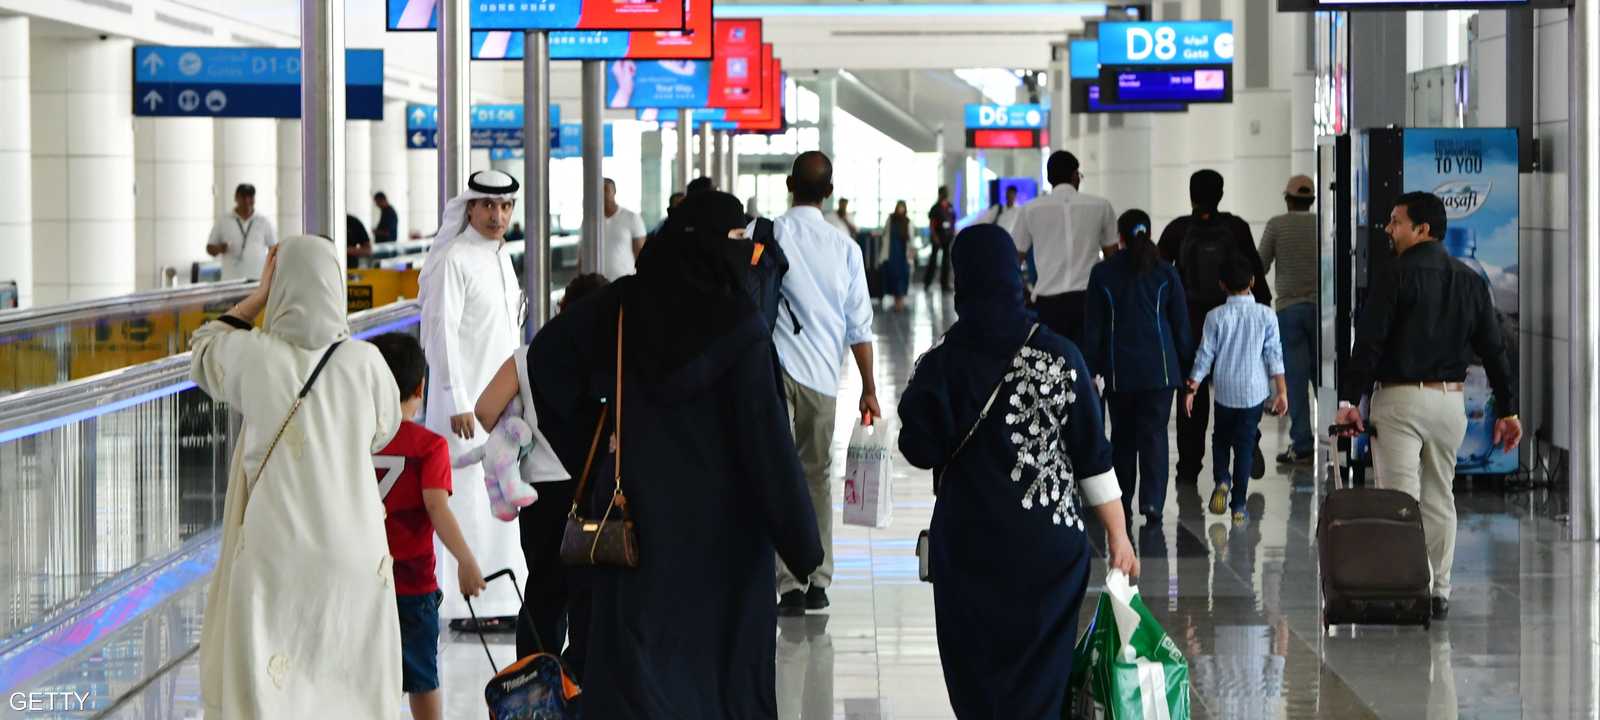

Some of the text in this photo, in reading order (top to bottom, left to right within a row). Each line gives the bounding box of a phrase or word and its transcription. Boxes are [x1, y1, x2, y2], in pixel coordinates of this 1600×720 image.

[1126, 26, 1177, 60] D8
[1183, 48, 1209, 59] Gate
[252, 57, 301, 75] D1-D
[979, 106, 1009, 126] D6
[1435, 157, 1482, 174] TO YOU
